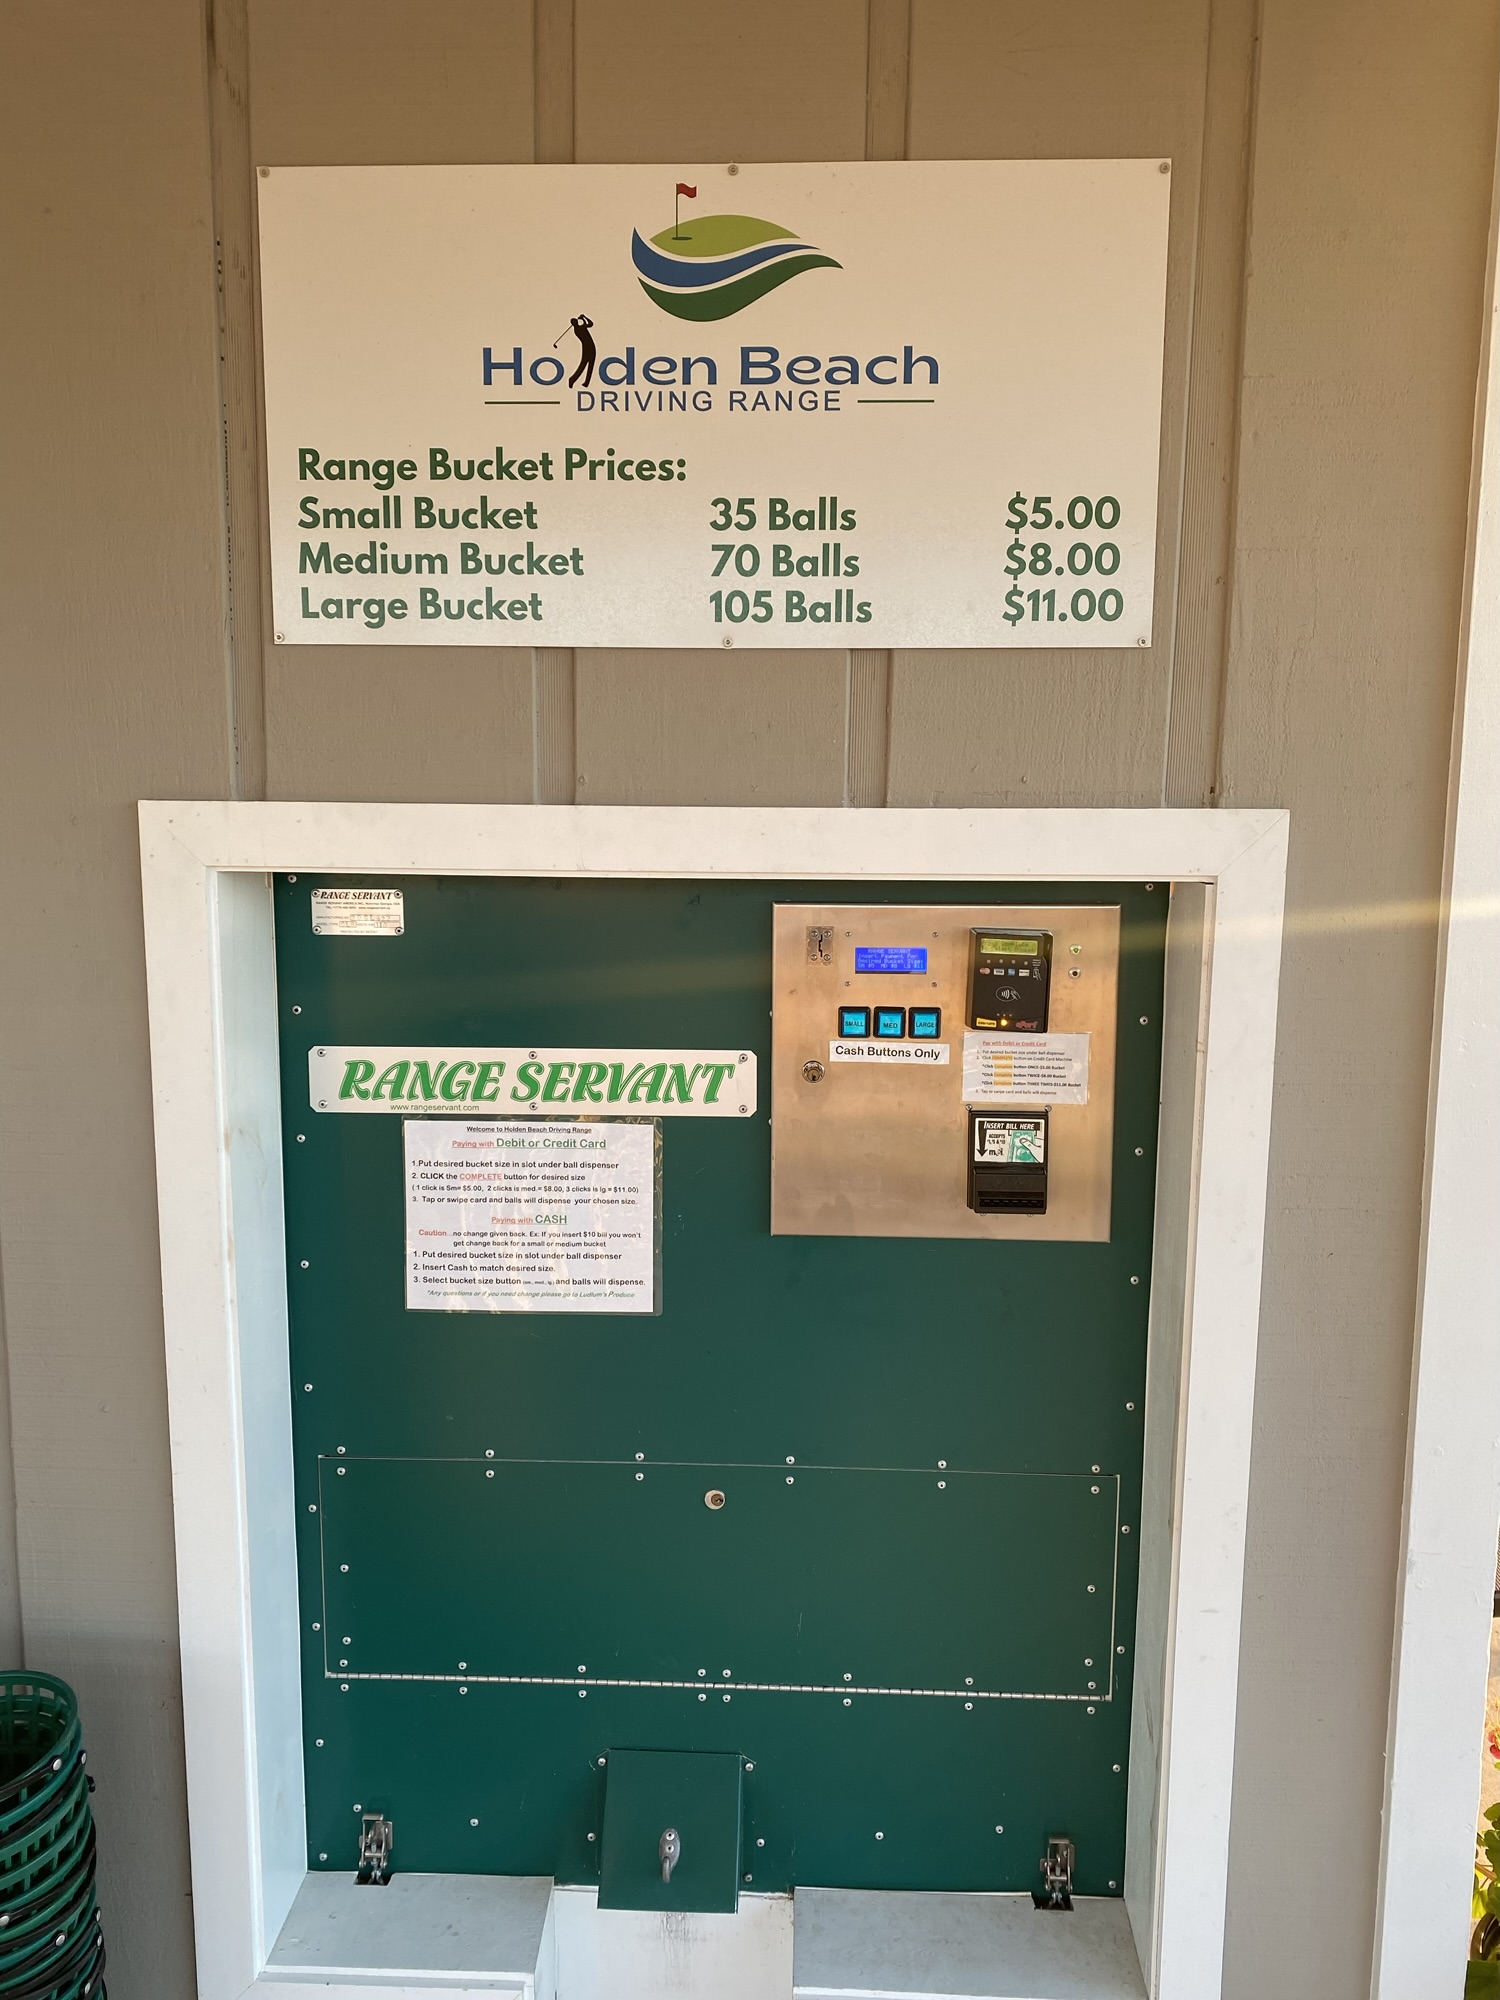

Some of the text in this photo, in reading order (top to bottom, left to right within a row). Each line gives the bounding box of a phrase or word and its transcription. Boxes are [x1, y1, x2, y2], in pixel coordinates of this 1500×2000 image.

[740, 346, 939, 386] Beach
[578, 390, 840, 411] DRIVING RANGE
[299, 447, 686, 490] Range Bucket Prices:
[298, 497, 538, 529] Small Bucket
[710, 497, 856, 531] 35 Balls
[1005, 492, 1120, 534] $5.00
[299, 543, 584, 575] Medium Bucket
[711, 544, 859, 577] 70 Balls
[1004, 538, 1120, 580] $8.00
[301, 588, 543, 629] Large Bucket
[710, 589, 872, 623] 105 Balls
[1002, 584, 1123, 626] $11.00
[320, 892, 392, 900] RANGE SERVANT
[836, 1046, 940, 1060] Cash Buttons Only
[339, 1060, 735, 1103] RANGE SERVANT
[984, 1121, 1004, 1129] INSERT
[452, 1140, 477, 1148] Paying
[496, 1138, 525, 1147] Debit
[543, 1139, 576, 1148] Credit
[580, 1139, 606, 1148] Card
[580, 1161, 619, 1170] dispenser
[422, 1196, 435, 1204] Tap
[447, 1196, 468, 1204] swipe
[538, 1197, 570, 1205] dispense
[535, 1215, 567, 1223] CASH
[463, 1230, 488, 1238] change
[490, 1230, 507, 1238] given
[584, 1231, 595, 1239] $10
[583, 1252, 622, 1261] dispenser
[443, 1289, 472, 1297] questions
[608, 1278, 645, 1287] dispense.
